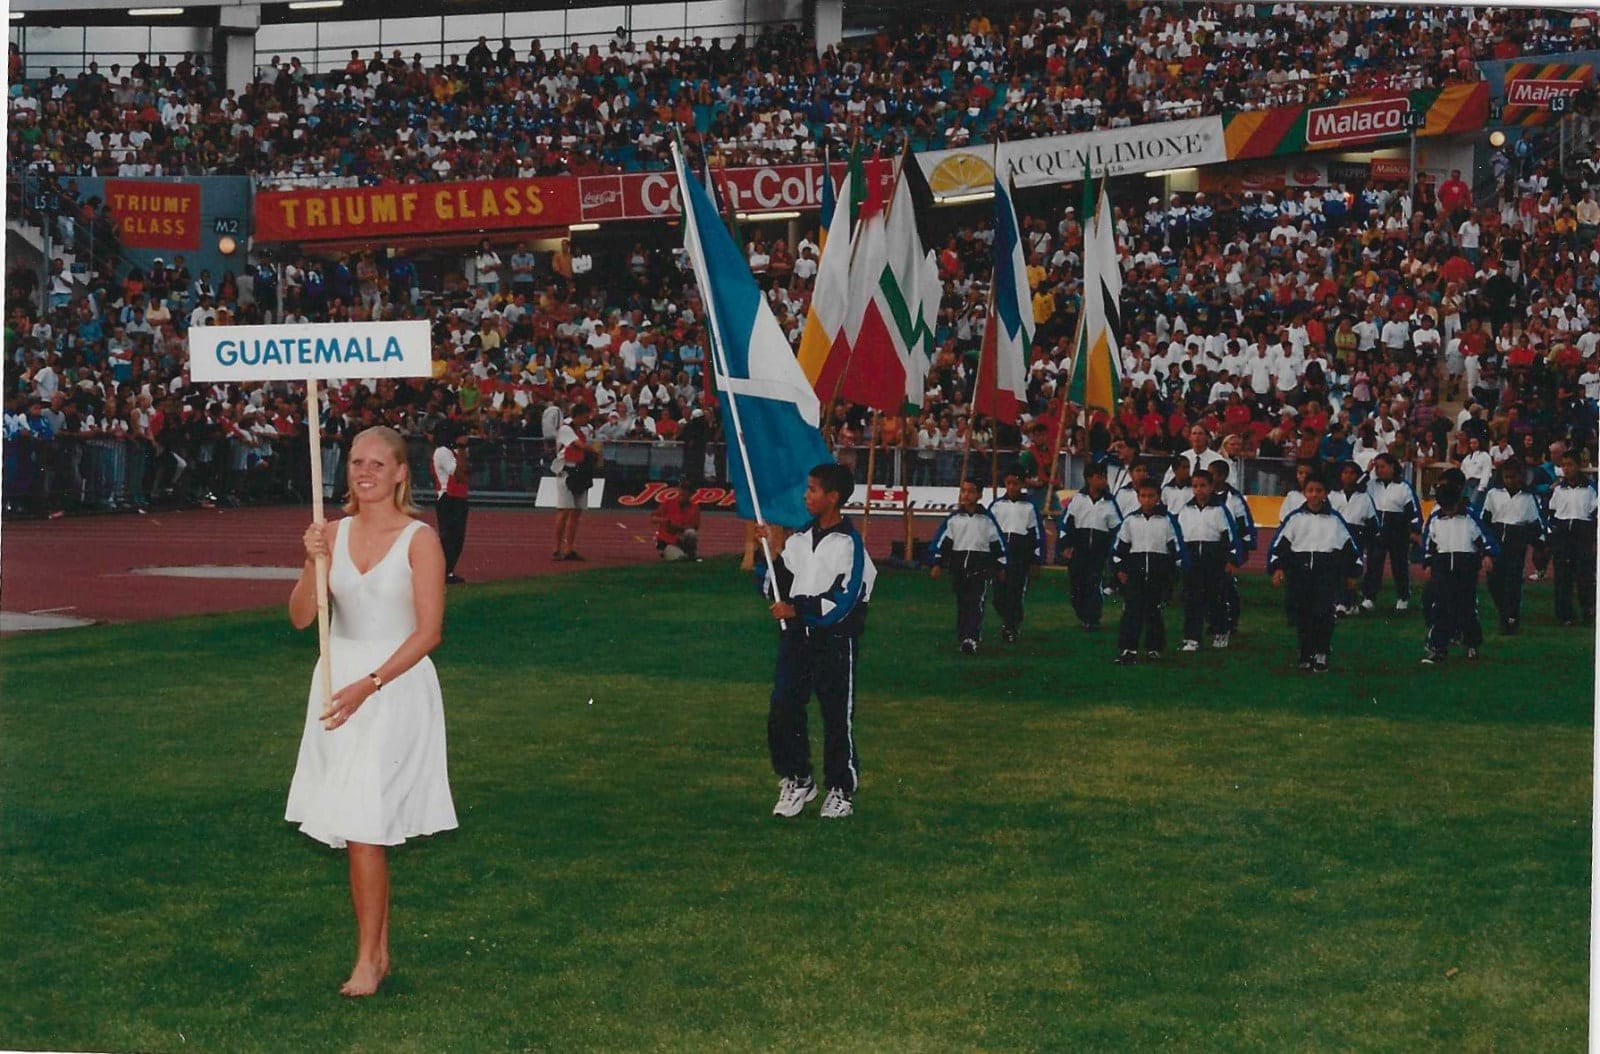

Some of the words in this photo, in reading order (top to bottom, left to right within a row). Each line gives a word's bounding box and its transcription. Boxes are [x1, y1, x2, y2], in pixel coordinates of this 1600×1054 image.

[1552, 98, 1564, 111] L3
[1314, 109, 1401, 136] Malaco
[114, 194, 191, 214] TRIUMF
[280, 192, 419, 230] TRIUMF
[433, 184, 546, 222] GLASS
[123, 216, 186, 236] GLASS
[216, 220, 239, 233] M2
[215, 335, 404, 367] GUATEMALA
